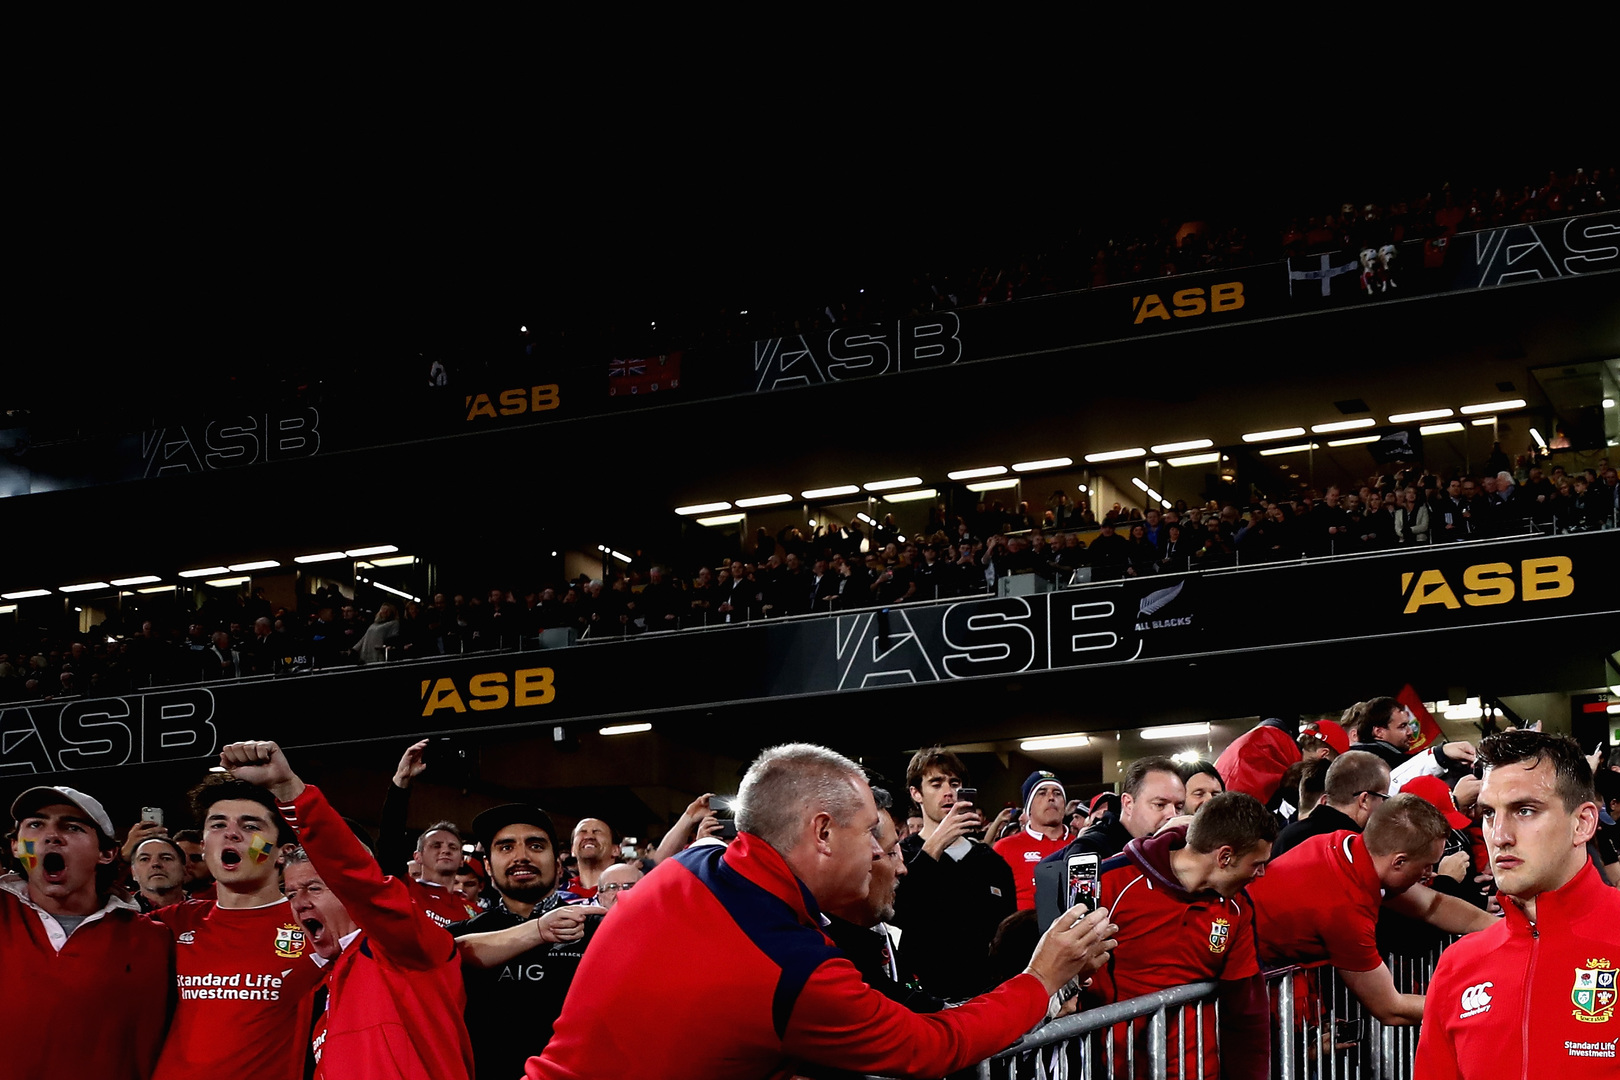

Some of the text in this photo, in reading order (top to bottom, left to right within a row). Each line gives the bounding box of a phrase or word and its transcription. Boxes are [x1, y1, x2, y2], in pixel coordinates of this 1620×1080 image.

[1132, 281, 1245, 324] ASB
[754, 311, 962, 392] ASB
[466, 383, 560, 421] ASB
[142, 406, 320, 478] ASB
[1401, 555, 1576, 615] ASB
[1135, 616, 1191, 631] ALL BLACKS
[421, 666, 556, 717] ASB
[245, 973, 282, 988] Life
[498, 964, 545, 982] AIG
[181, 987, 280, 1000] Investments
[1564, 1041, 1616, 1051] Standard Life
[1568, 1049, 1616, 1058] Investments
